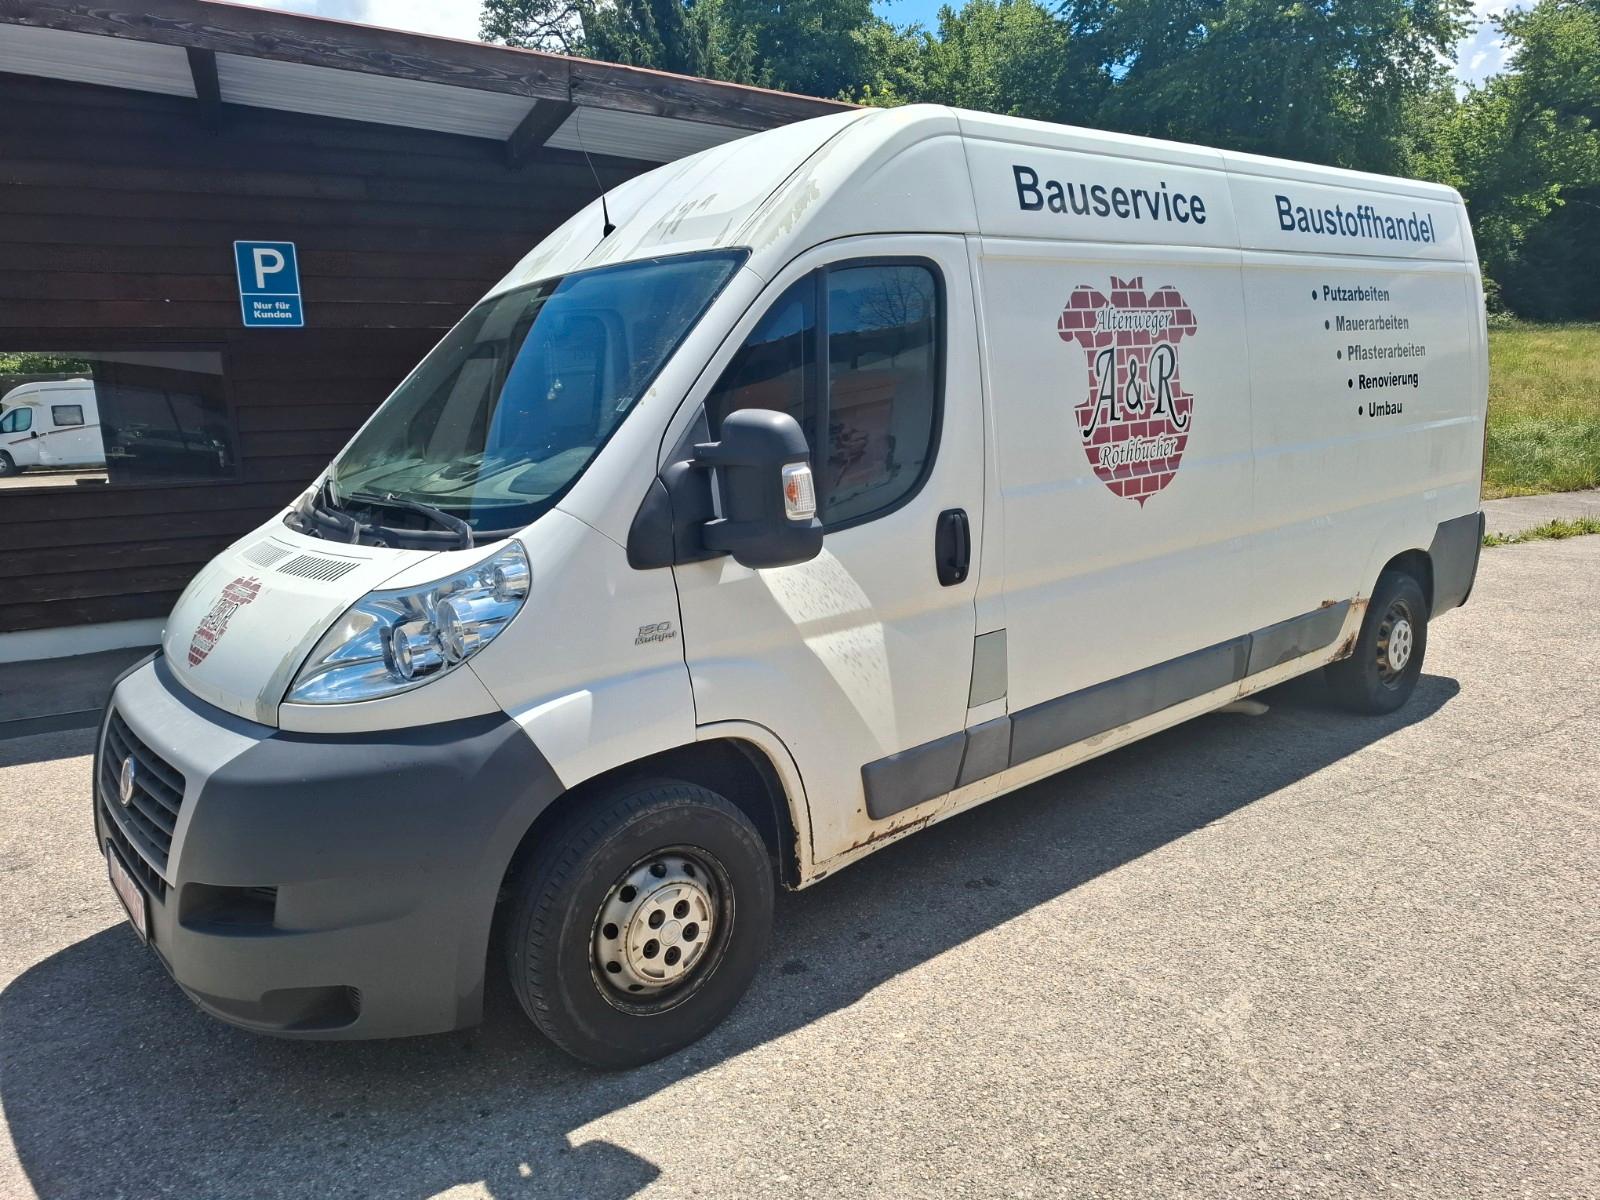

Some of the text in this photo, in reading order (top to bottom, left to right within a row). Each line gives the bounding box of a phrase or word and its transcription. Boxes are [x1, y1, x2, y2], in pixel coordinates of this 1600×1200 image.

[1012, 164, 1207, 225] Bauservice
[1274, 194, 1436, 243] Baustoffhandel
[253, 247, 285, 289] P
[1322, 284, 1390, 302] Putzarbeiten
[253, 301, 290, 310] Nur für
[253, 310, 292, 319] Kunden
[1094, 306, 1171, 336] Altenweger
[1335, 314, 1409, 332] Mauerarbeiten
[1347, 342, 1426, 361] Pflasterarbeiten
[1358, 371, 1419, 389] Renovierung
[1368, 400, 1403, 418] Umbau
[1099, 439, 1176, 466] Rothbucher
